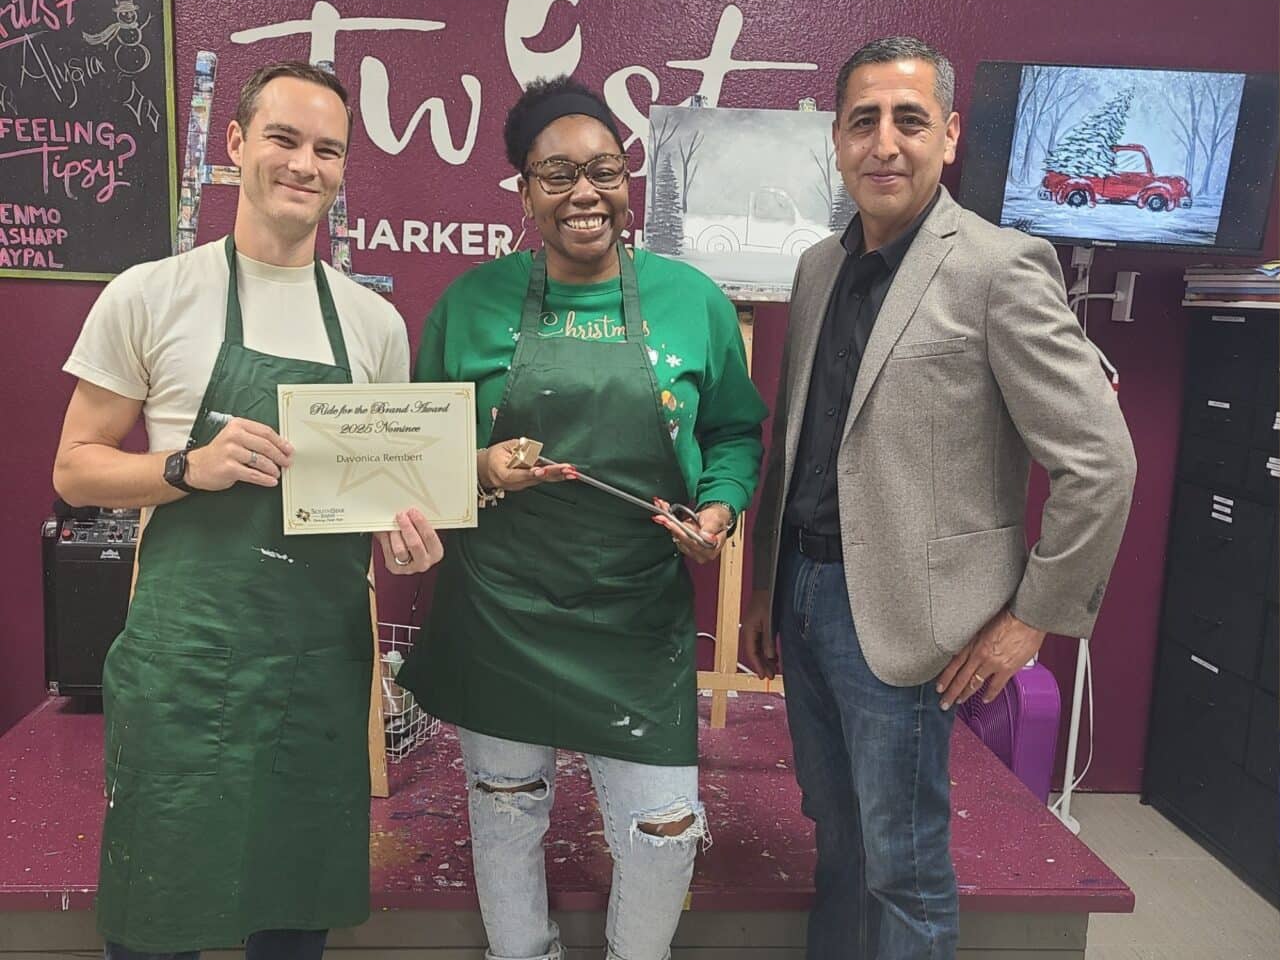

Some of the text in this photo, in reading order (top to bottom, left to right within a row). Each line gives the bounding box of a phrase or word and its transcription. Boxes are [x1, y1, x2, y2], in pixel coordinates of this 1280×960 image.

[0, 118, 115, 150] FEELING
[0, 133, 137, 203] Tipsy?
[0, 203, 61, 225] ENMO
[0, 227, 69, 245] ASHAPP
[349, 218, 514, 257] HARKER
[0, 248, 64, 269] AYPAL
[538, 310, 650, 339] Christms
[310, 400, 450, 417] Ride for the Brand Award
[340, 420, 421, 434] 2025 Nominee
[336, 453, 423, 464] Davonica Rembert
